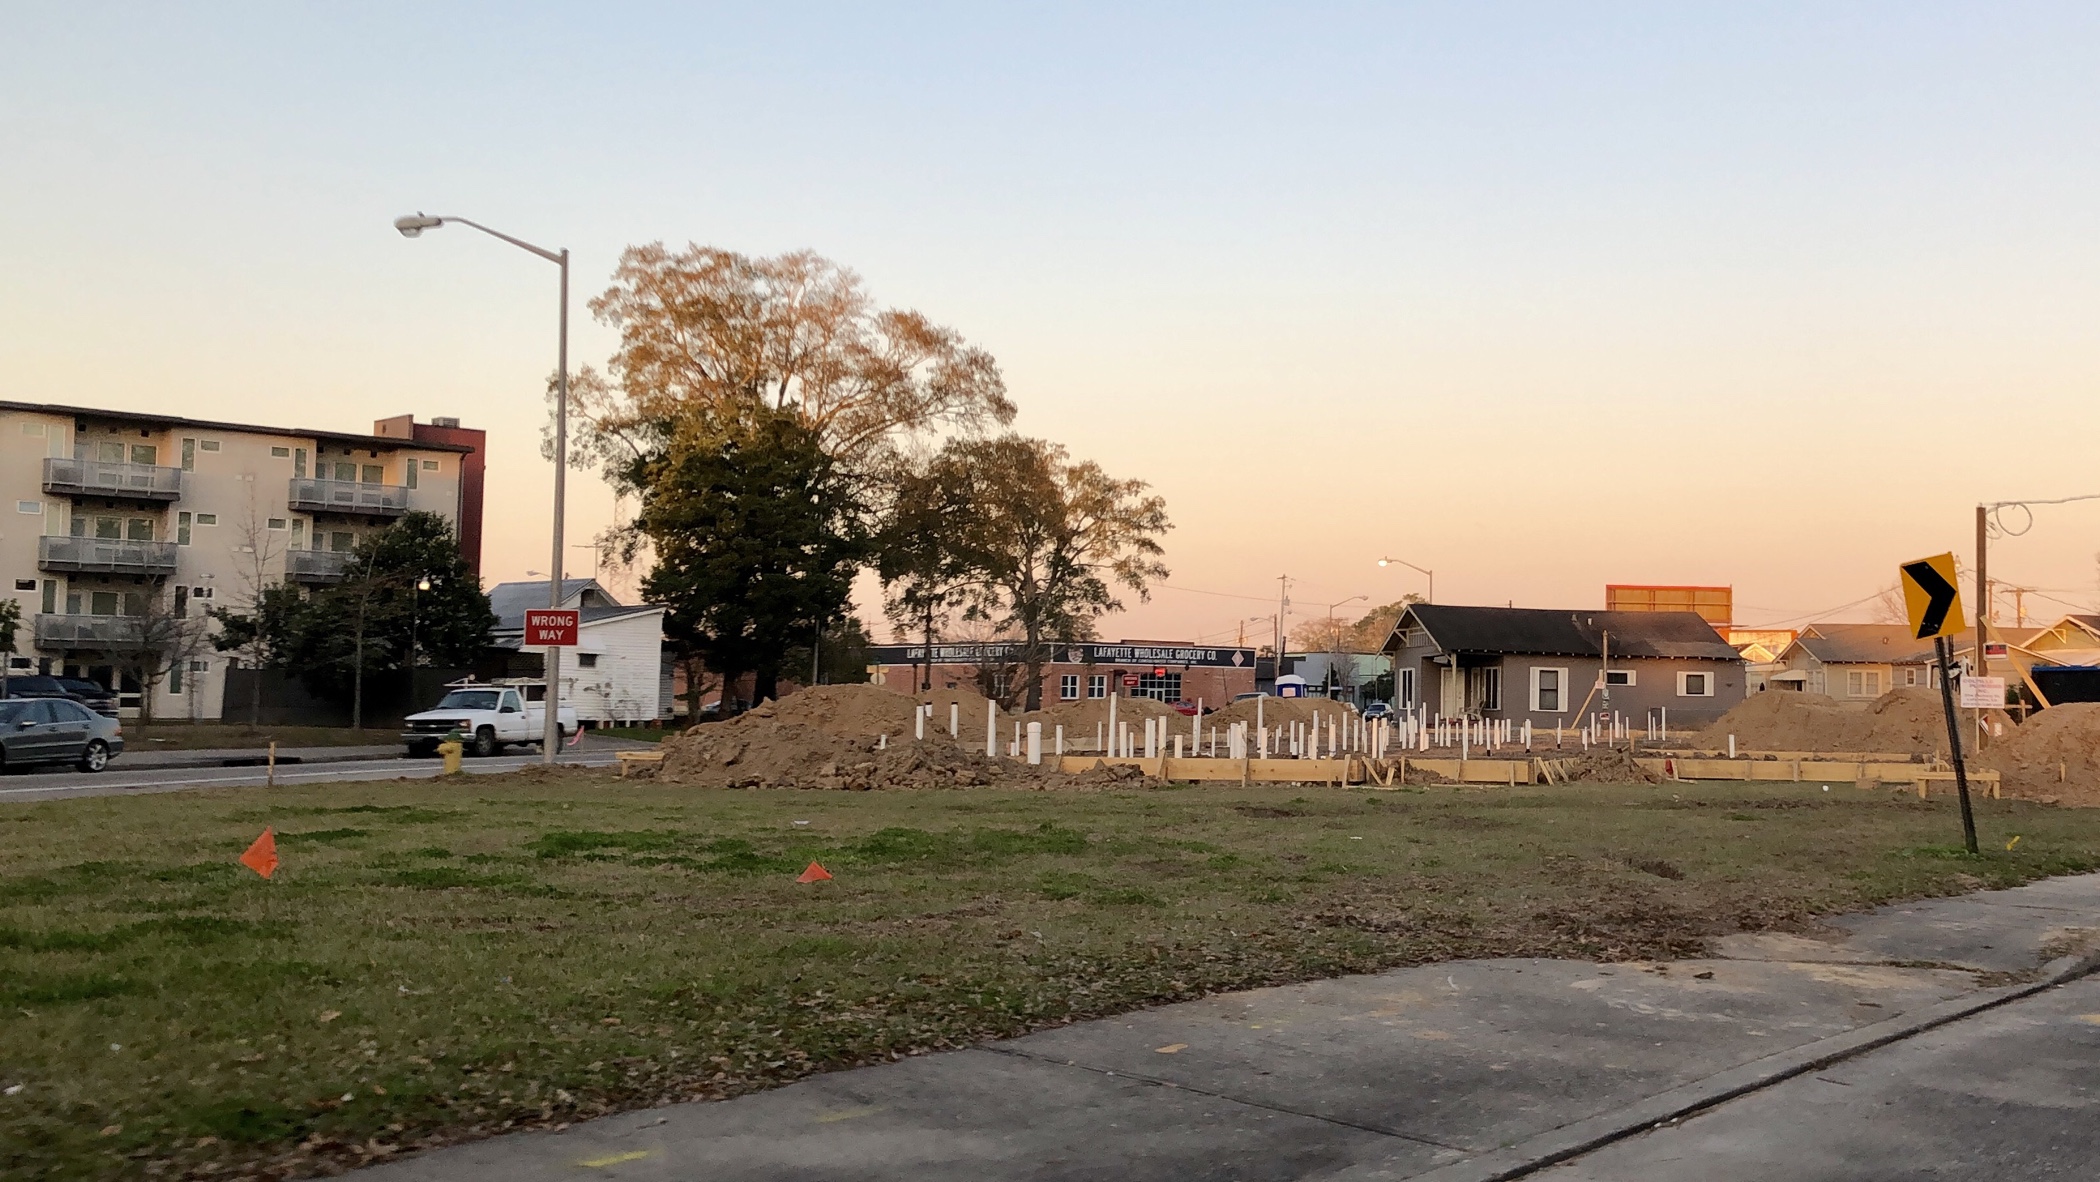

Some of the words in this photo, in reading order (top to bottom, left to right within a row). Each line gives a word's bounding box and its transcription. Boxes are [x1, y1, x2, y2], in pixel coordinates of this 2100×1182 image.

[531, 615, 574, 627] WRONG
[538, 629, 565, 640] WAY
[1093, 646, 1132, 658] LAFAYETTE
[1134, 648, 1173, 659] WHOLESALE
[1175, 649, 1206, 660] GROCERY
[1206, 650, 1218, 661] CO.
